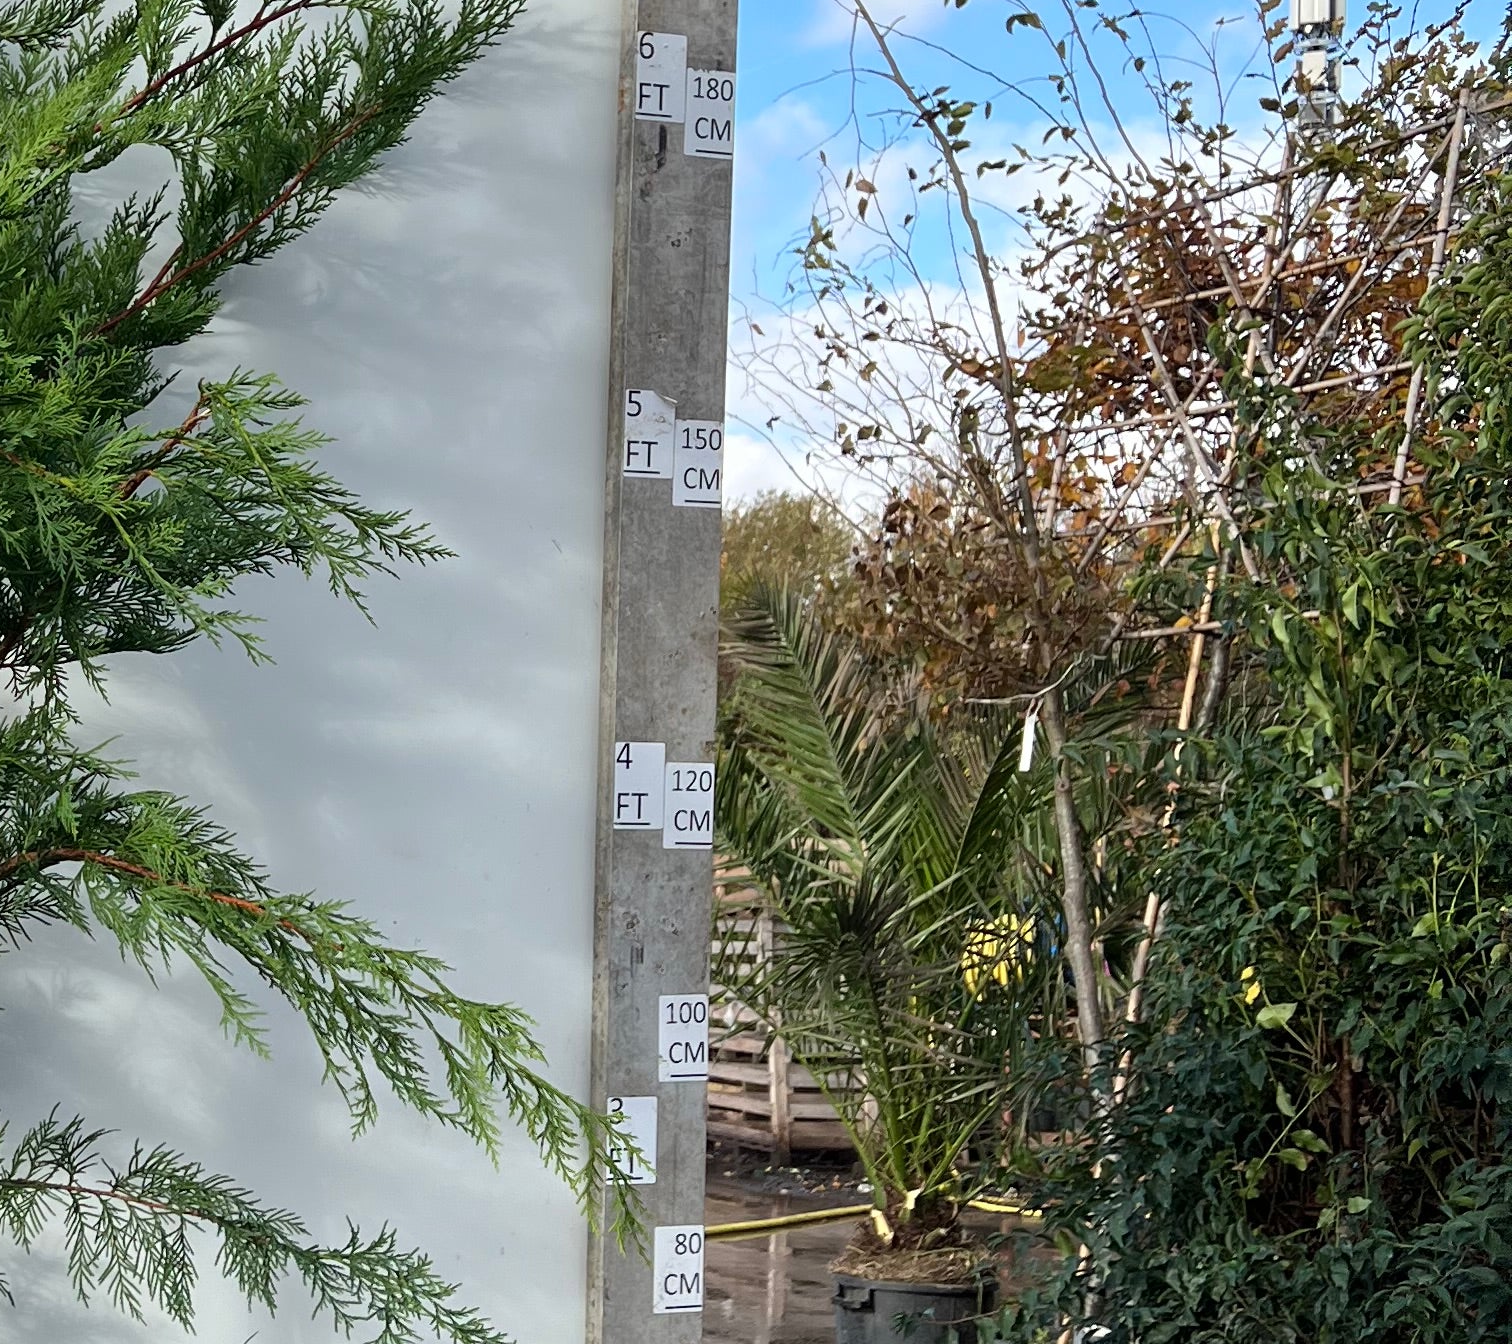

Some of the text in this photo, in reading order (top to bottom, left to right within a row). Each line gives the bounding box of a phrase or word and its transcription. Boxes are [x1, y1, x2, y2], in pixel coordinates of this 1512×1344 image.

[639, 32, 655, 60] 6
[638, 82, 670, 111] FT
[693, 76, 734, 102] 180
[694, 117, 731, 141] CM
[626, 390, 642, 417] 5
[681, 427, 722, 451] 150
[626, 439, 659, 468] FT
[683, 467, 720, 490] CM
[616, 742, 633, 770] 4
[672, 769, 713, 793] 120
[617, 792, 649, 820] FT
[674, 809, 710, 832] CM
[666, 1001, 707, 1025] 100
[668, 1041, 705, 1064] CM
[674, 1232, 702, 1255] 80
[663, 1272, 700, 1296] CM
